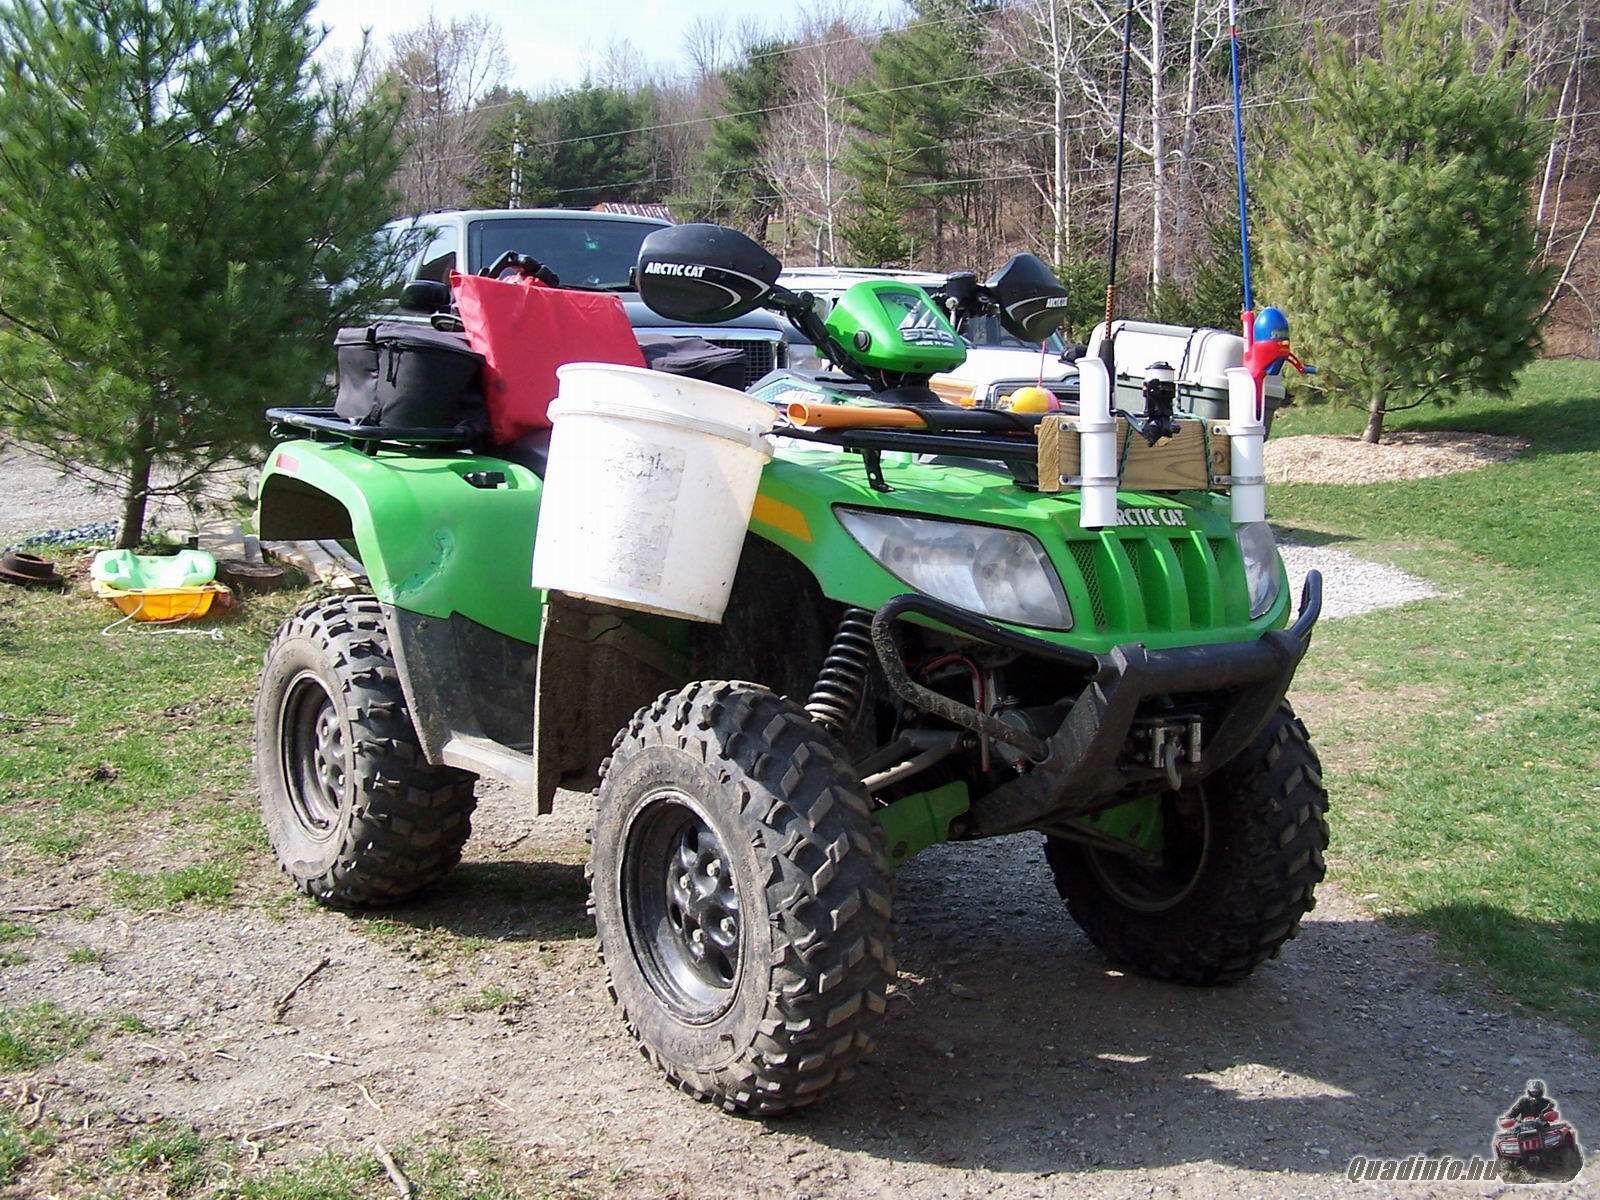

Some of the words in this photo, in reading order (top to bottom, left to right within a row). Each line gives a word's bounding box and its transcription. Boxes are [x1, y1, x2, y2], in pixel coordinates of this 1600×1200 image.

[644, 261, 684, 276] ARCTIC
[683, 265, 706, 278] CAT
[1116, 508, 1160, 526] RCTIC
[1159, 508, 1187, 526] CAT
